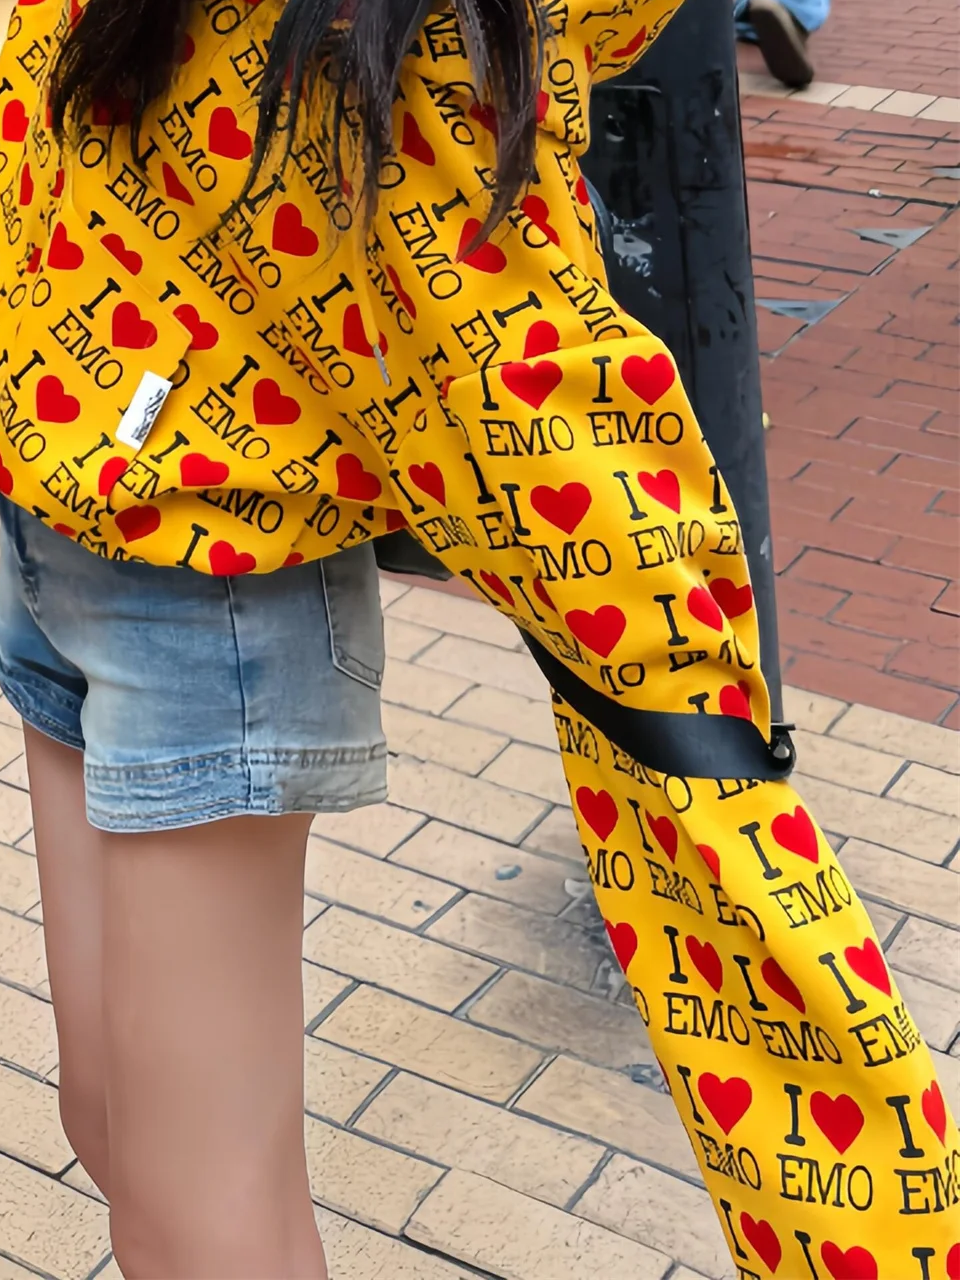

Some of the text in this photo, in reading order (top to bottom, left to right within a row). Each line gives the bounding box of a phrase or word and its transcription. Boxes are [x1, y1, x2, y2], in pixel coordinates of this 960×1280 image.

[184, 77, 222, 118] I
[158, 107, 218, 193] EMO
[105, 163, 180, 241] EMO
[431, 188, 470, 222] I
[179, 236, 255, 316] EMO
[389, 202, 462, 300] EMO
[80, 277, 121, 319] I
[311, 272, 355, 313] I
[492, 291, 542, 328] I
[48, 308, 123, 389] EMO
[284, 297, 355, 388] EMO
[10, 350, 45, 390] I
[220, 355, 260, 398] I
[592, 356, 613, 403] I
[384, 376, 422, 417] I
[149, 430, 190, 464] I
[190, 387, 270, 459] EMO
[303, 429, 342, 467] I
[480, 415, 574, 456] EMO
[586, 411, 683, 447] EMO
[73, 432, 114, 469] I
[389, 469, 425, 515] I
[500, 483, 531, 536] I
[613, 471, 648, 520] I
[709, 465, 727, 514] I
[176, 523, 209, 569] I
[509, 576, 545, 623] I
[653, 594, 689, 646] I
[739, 822, 782, 880] I
[769, 865, 851, 928] EMO
[663, 925, 688, 984] I
[733, 955, 768, 1011] I
[818, 952, 867, 1014] I
[663, 992, 750, 1045] EMO
[751, 1017, 843, 1064] EMO
[677, 1065, 704, 1125] I
[784, 1083, 805, 1146] I
[885, 1095, 925, 1158] I
[776, 1153, 873, 1211] EMO
[720, 1198, 749, 1260] I
